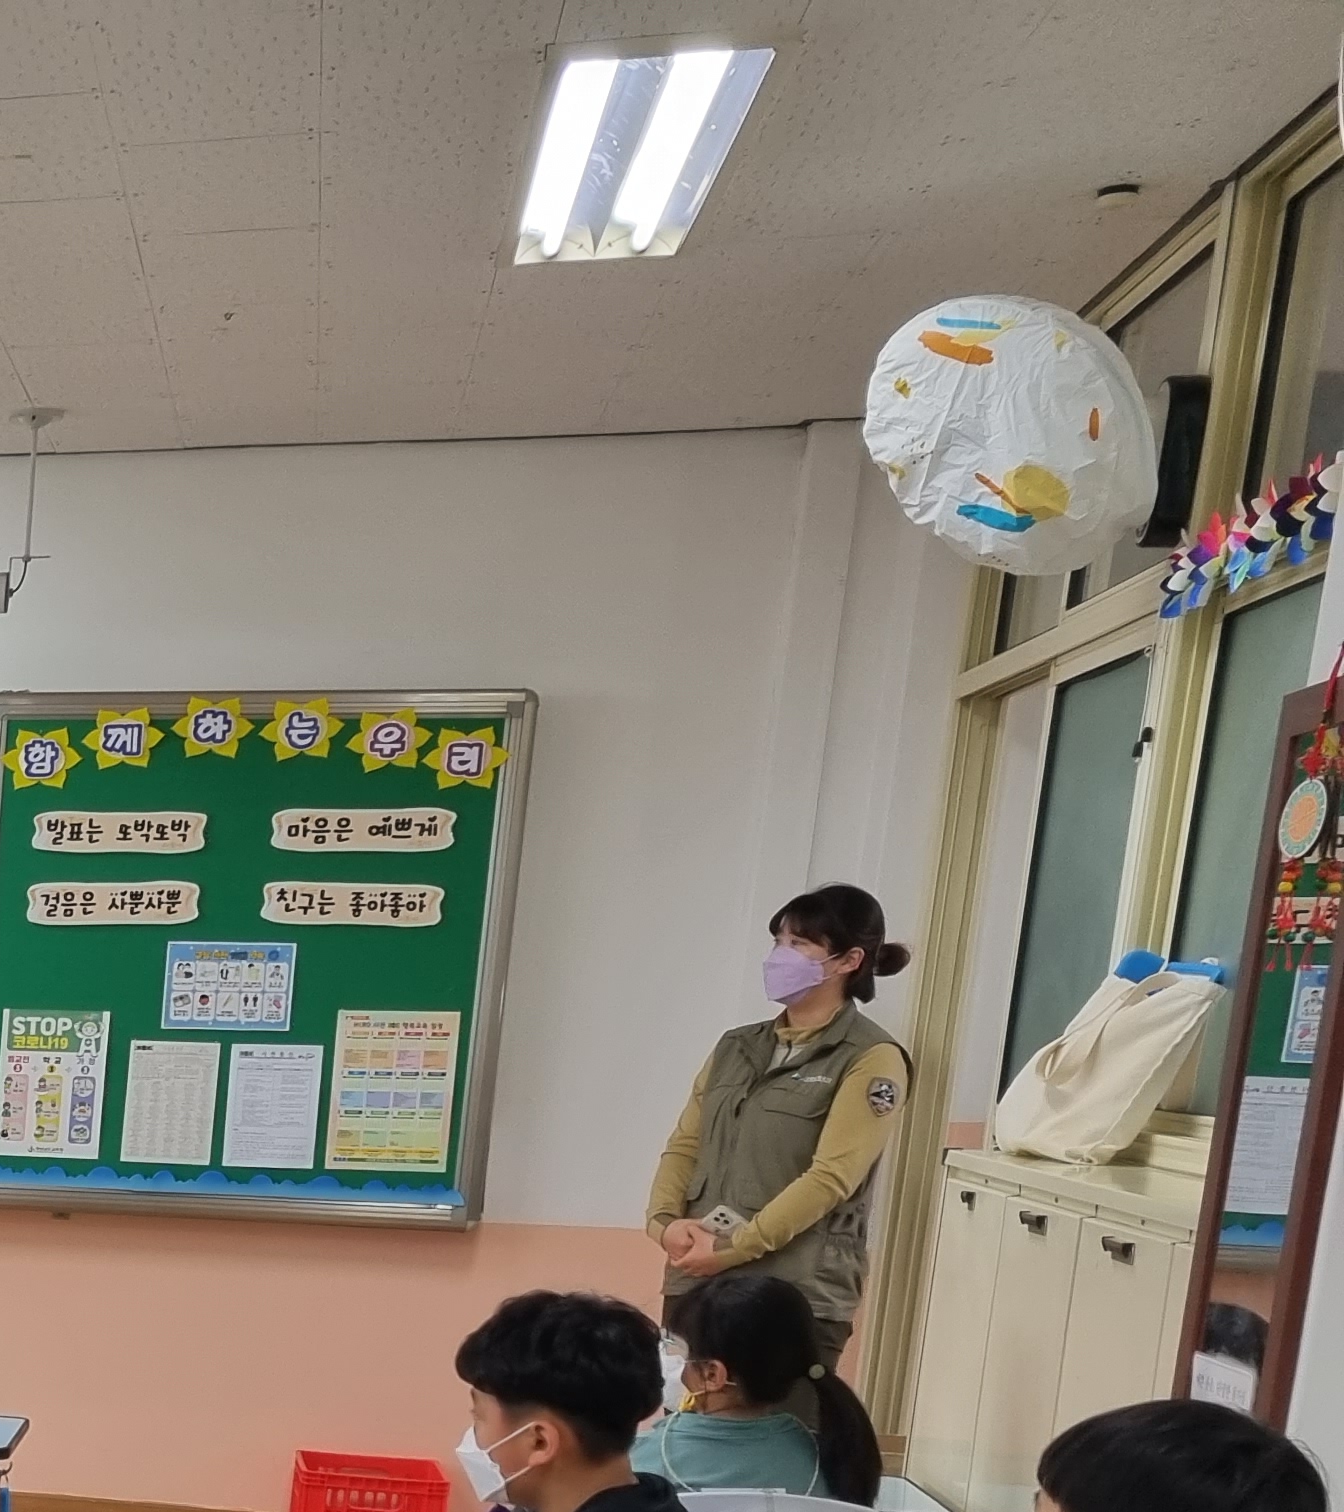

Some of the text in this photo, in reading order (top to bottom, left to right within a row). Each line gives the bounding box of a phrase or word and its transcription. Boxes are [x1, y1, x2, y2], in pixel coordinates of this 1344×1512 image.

[47, 818, 191, 845] 발표는 또박또박
[287, 815, 438, 844] 마음은 예쁘게
[40, 889, 182, 917] 걸음은 사뿐사뿐
[276, 888, 426, 918] 친구는 좋아좋아
[12, 1016, 72, 1036] STOP
[13, 1036, 69, 1049] 코로나19
